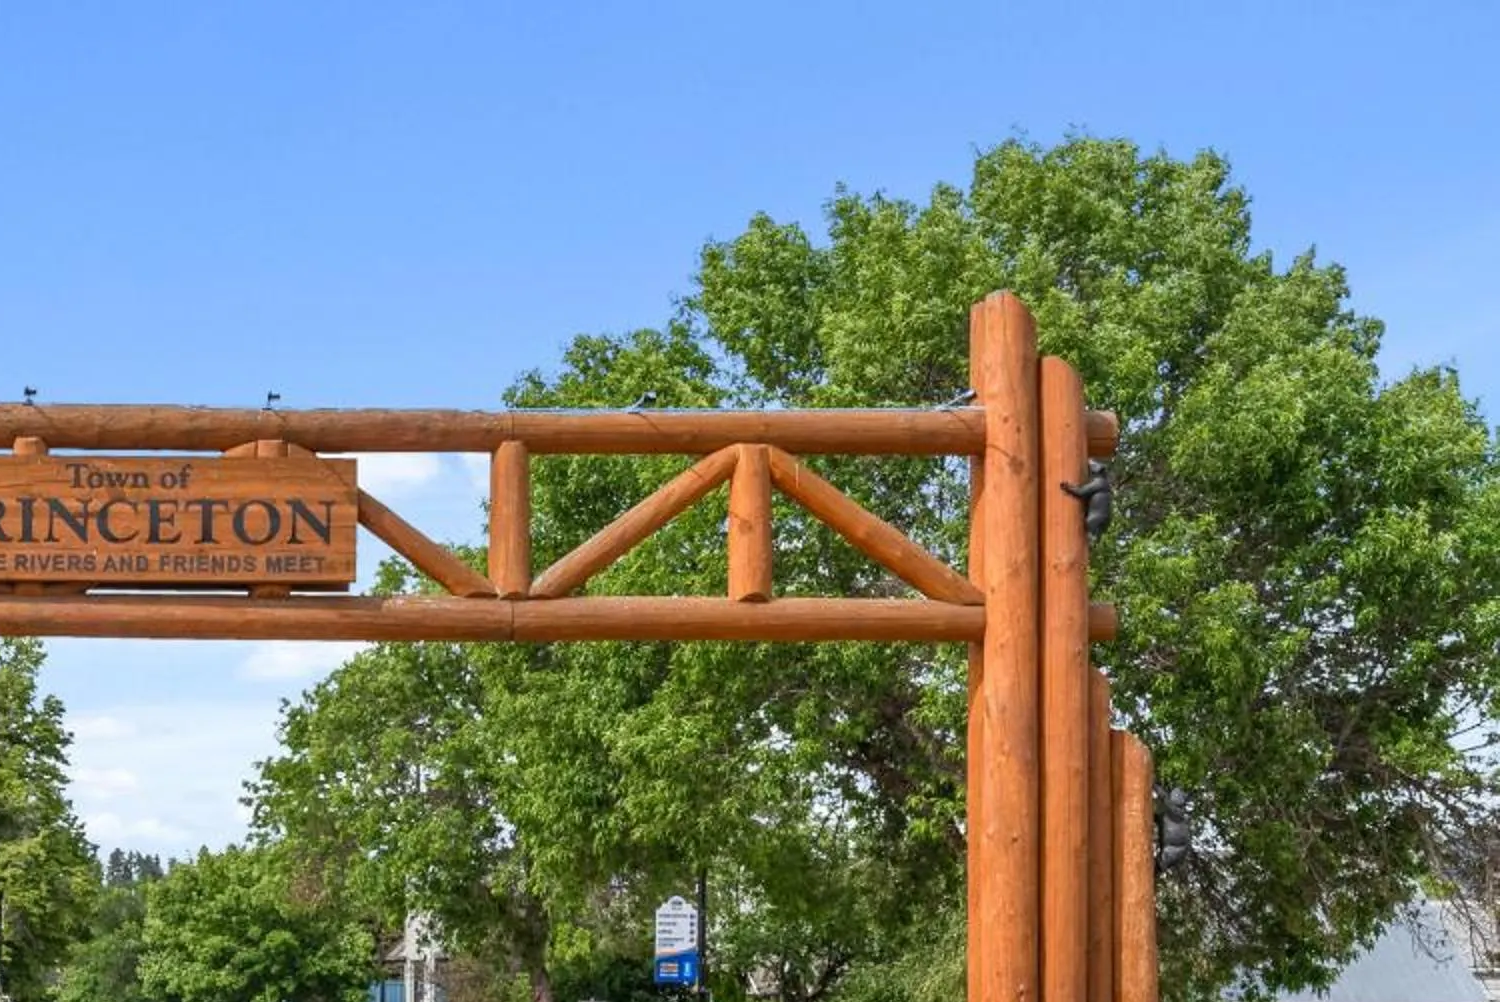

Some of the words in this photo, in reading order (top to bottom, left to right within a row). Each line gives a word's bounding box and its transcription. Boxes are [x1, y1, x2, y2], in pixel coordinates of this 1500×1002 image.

[66, 463, 149, 488] Town
[160, 464, 193, 489] of
[14, 553, 96, 573] RIVERS
[103, 554, 149, 573] AND
[159, 555, 258, 574] FRIENDS
[265, 556, 327, 574] MEET
